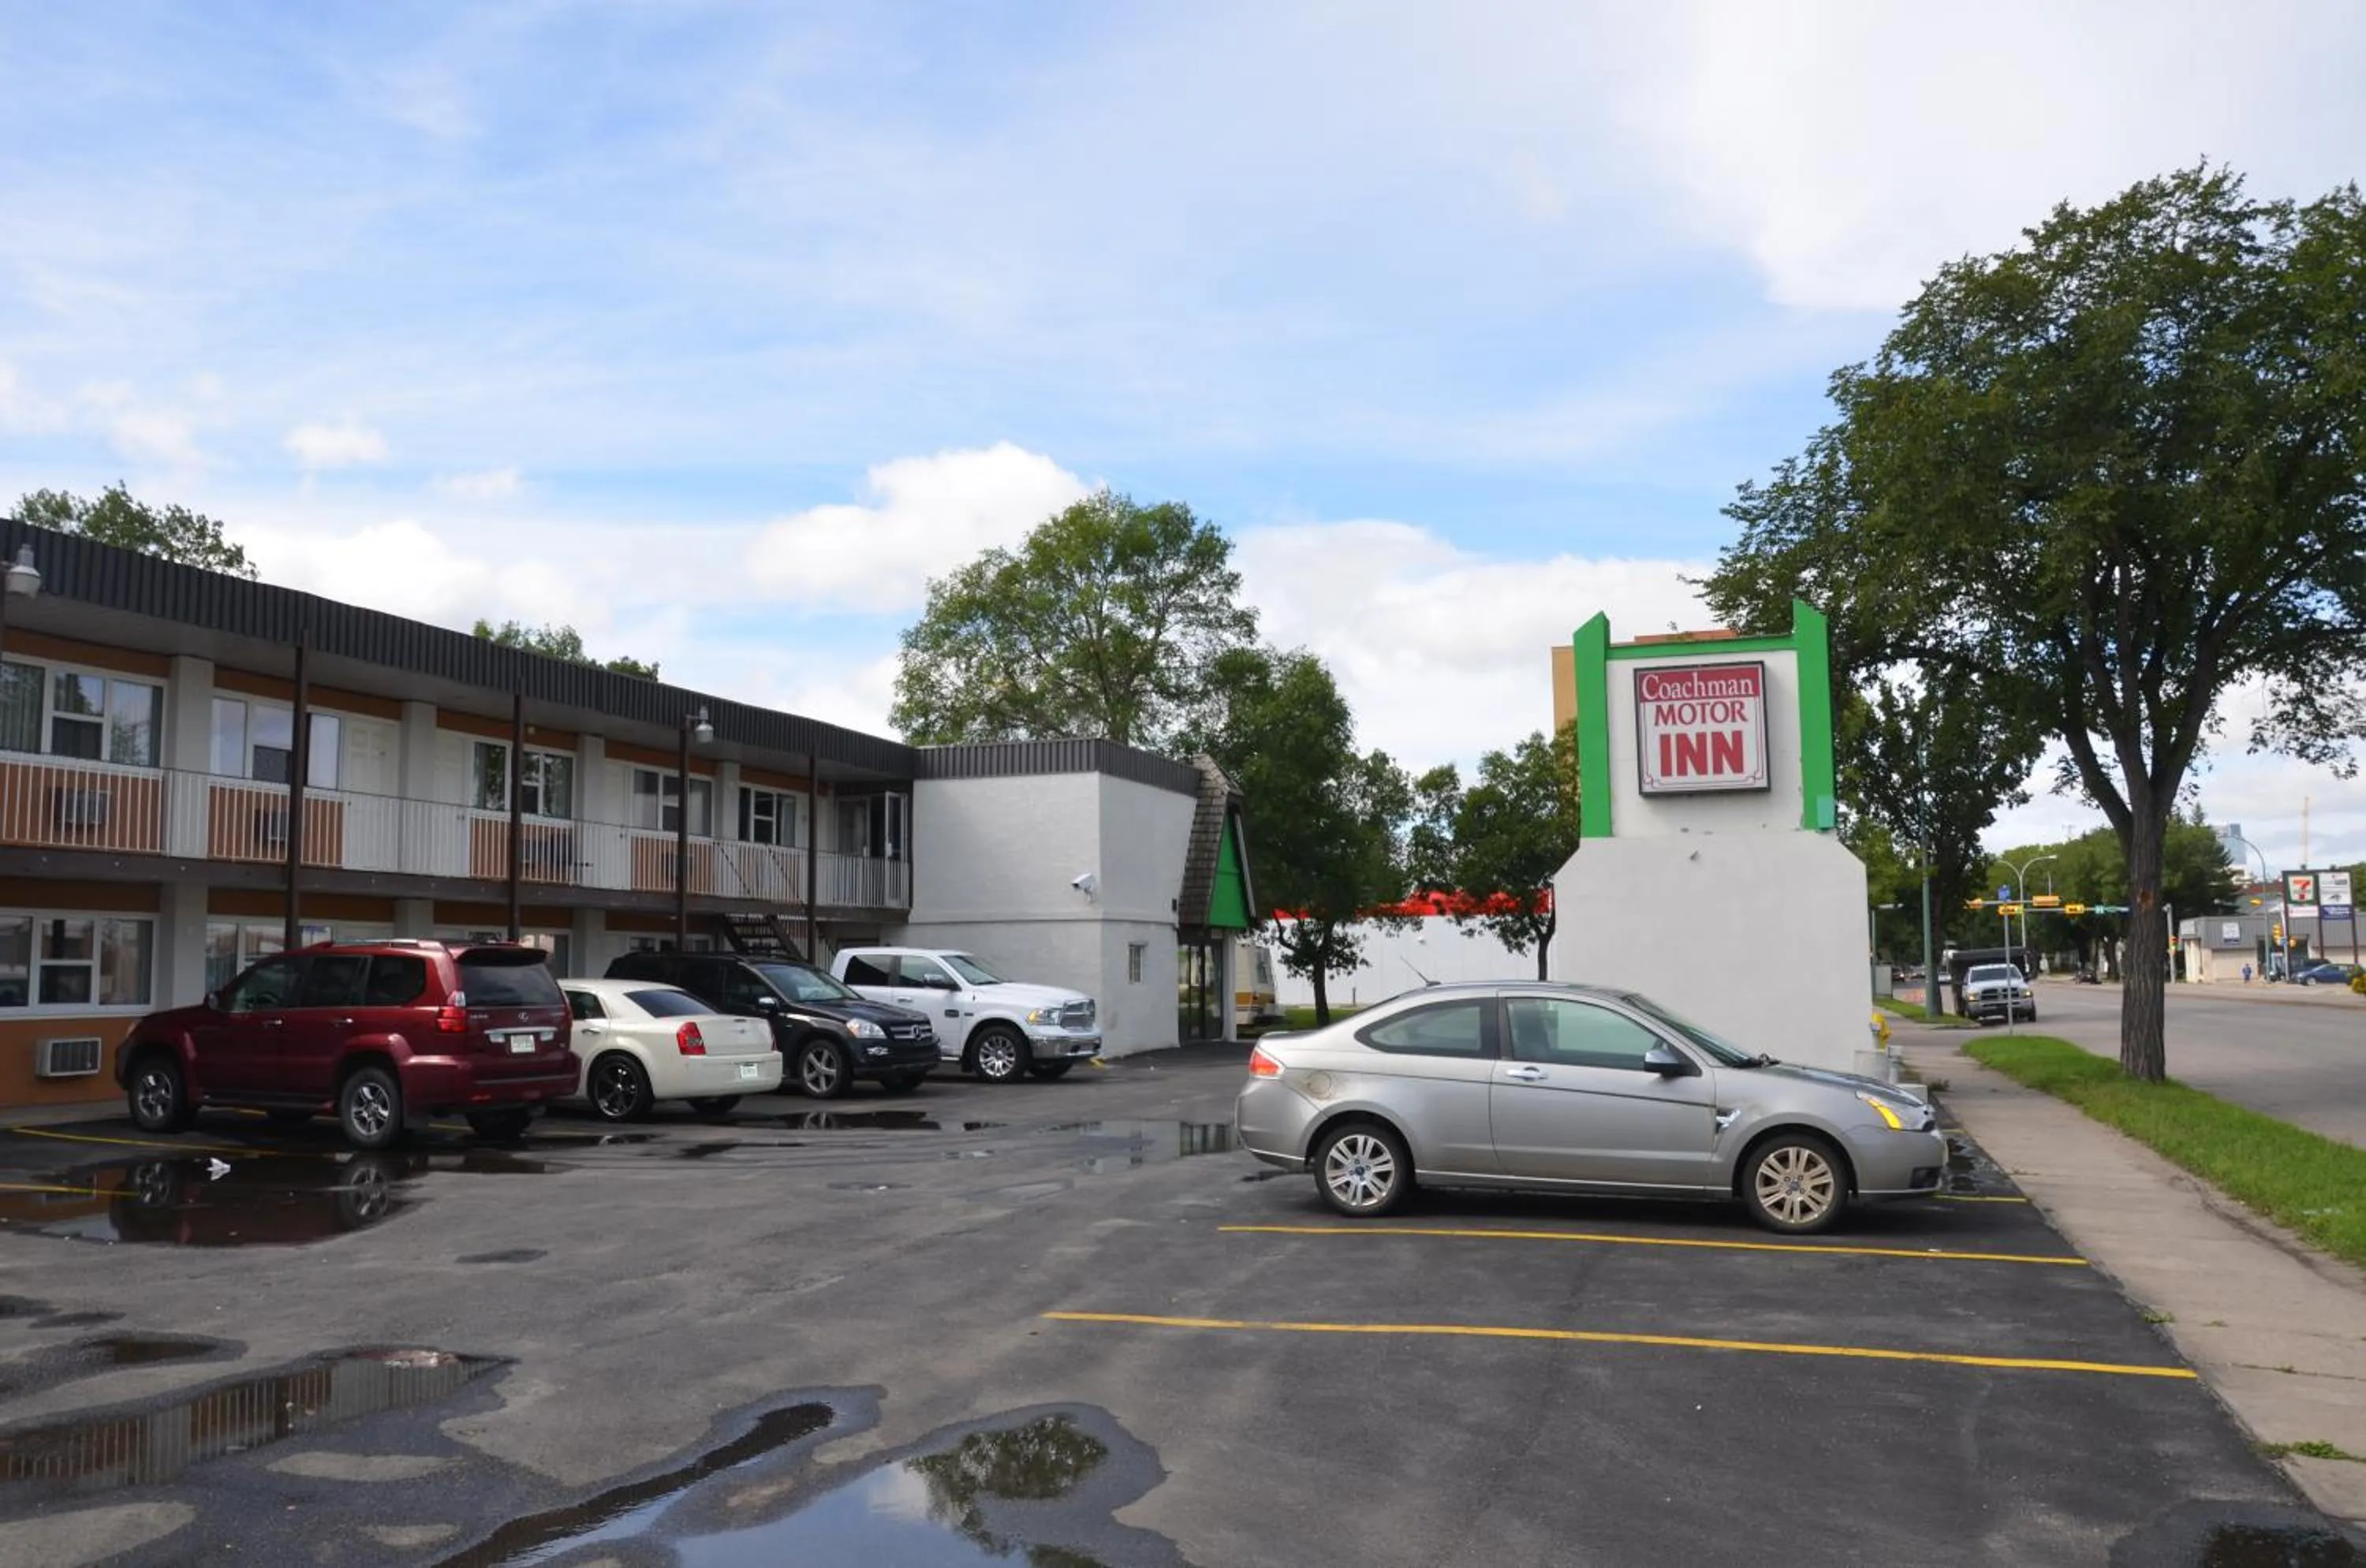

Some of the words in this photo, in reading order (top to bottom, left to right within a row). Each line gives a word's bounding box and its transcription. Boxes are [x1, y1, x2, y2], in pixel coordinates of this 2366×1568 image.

[1641, 672, 1754, 700] Coachman
[1654, 700, 1748, 726] MOTOR
[1659, 730, 1745, 777] INN
